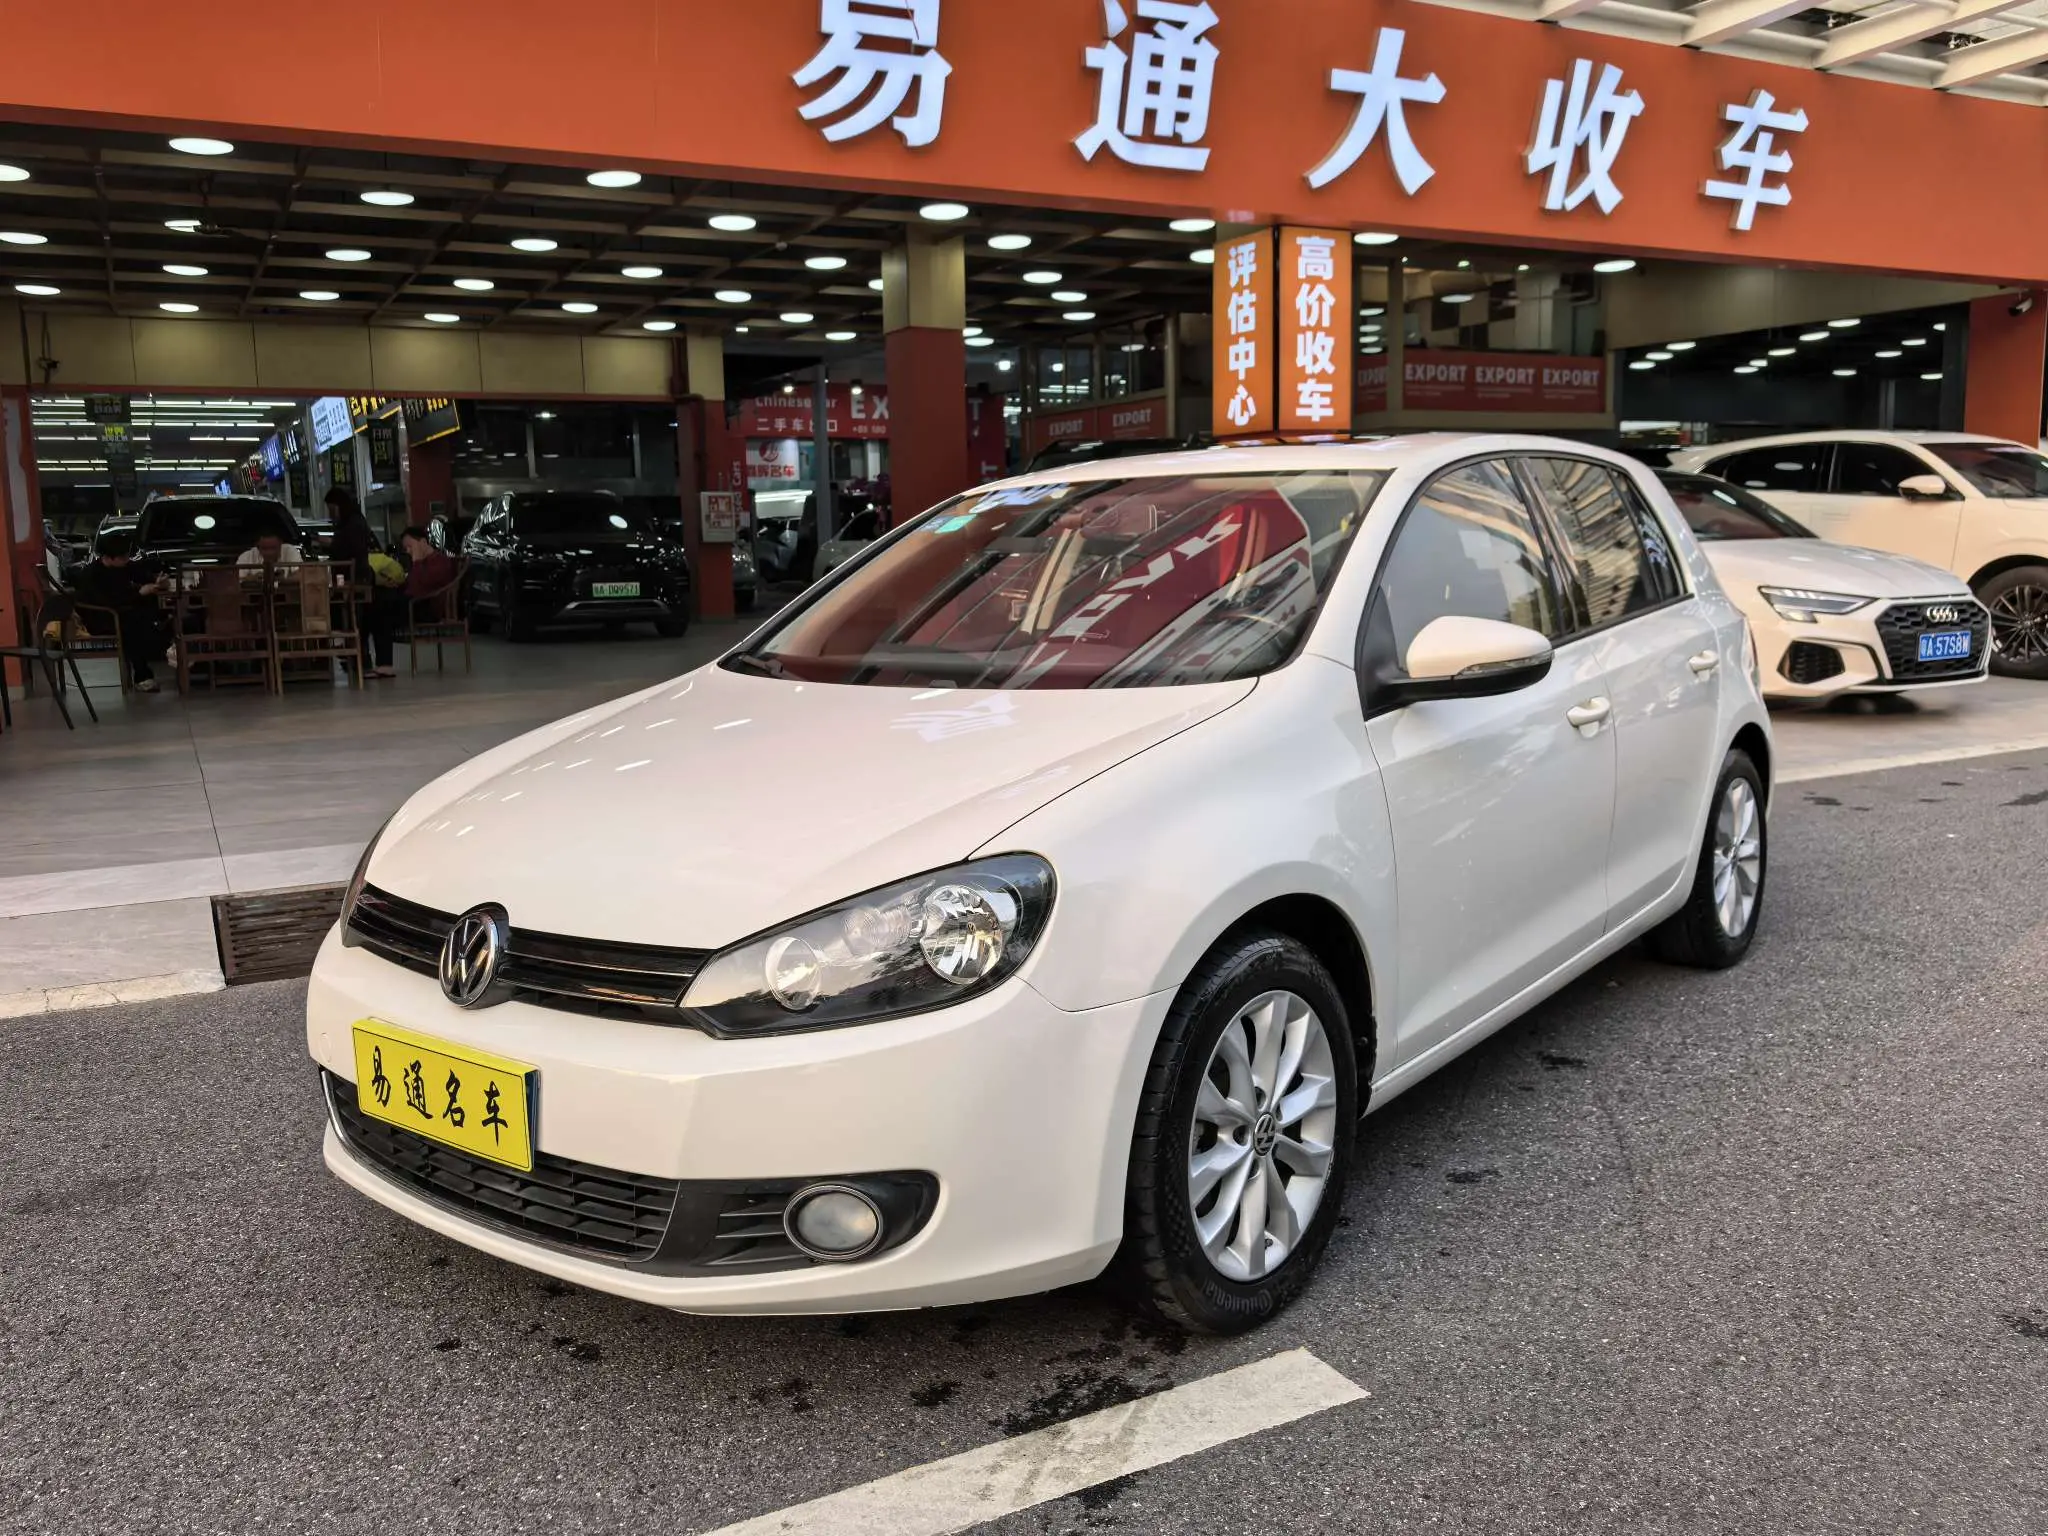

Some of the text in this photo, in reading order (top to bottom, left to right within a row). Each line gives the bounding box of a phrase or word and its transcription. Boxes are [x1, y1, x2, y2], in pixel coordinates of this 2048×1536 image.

[792, 0, 1810, 231] 易通大收车
[1227, 241, 1256, 426] 评估中心
[1296, 236, 1336, 422] 高价收车
[1405, 363, 1600, 387] EXPORT EXPORT EXPORT
[756, 417, 838, 432] 二手车口
[1112, 408, 1152, 428] EXPORT
[371, 1045, 508, 1147] 易通名车
